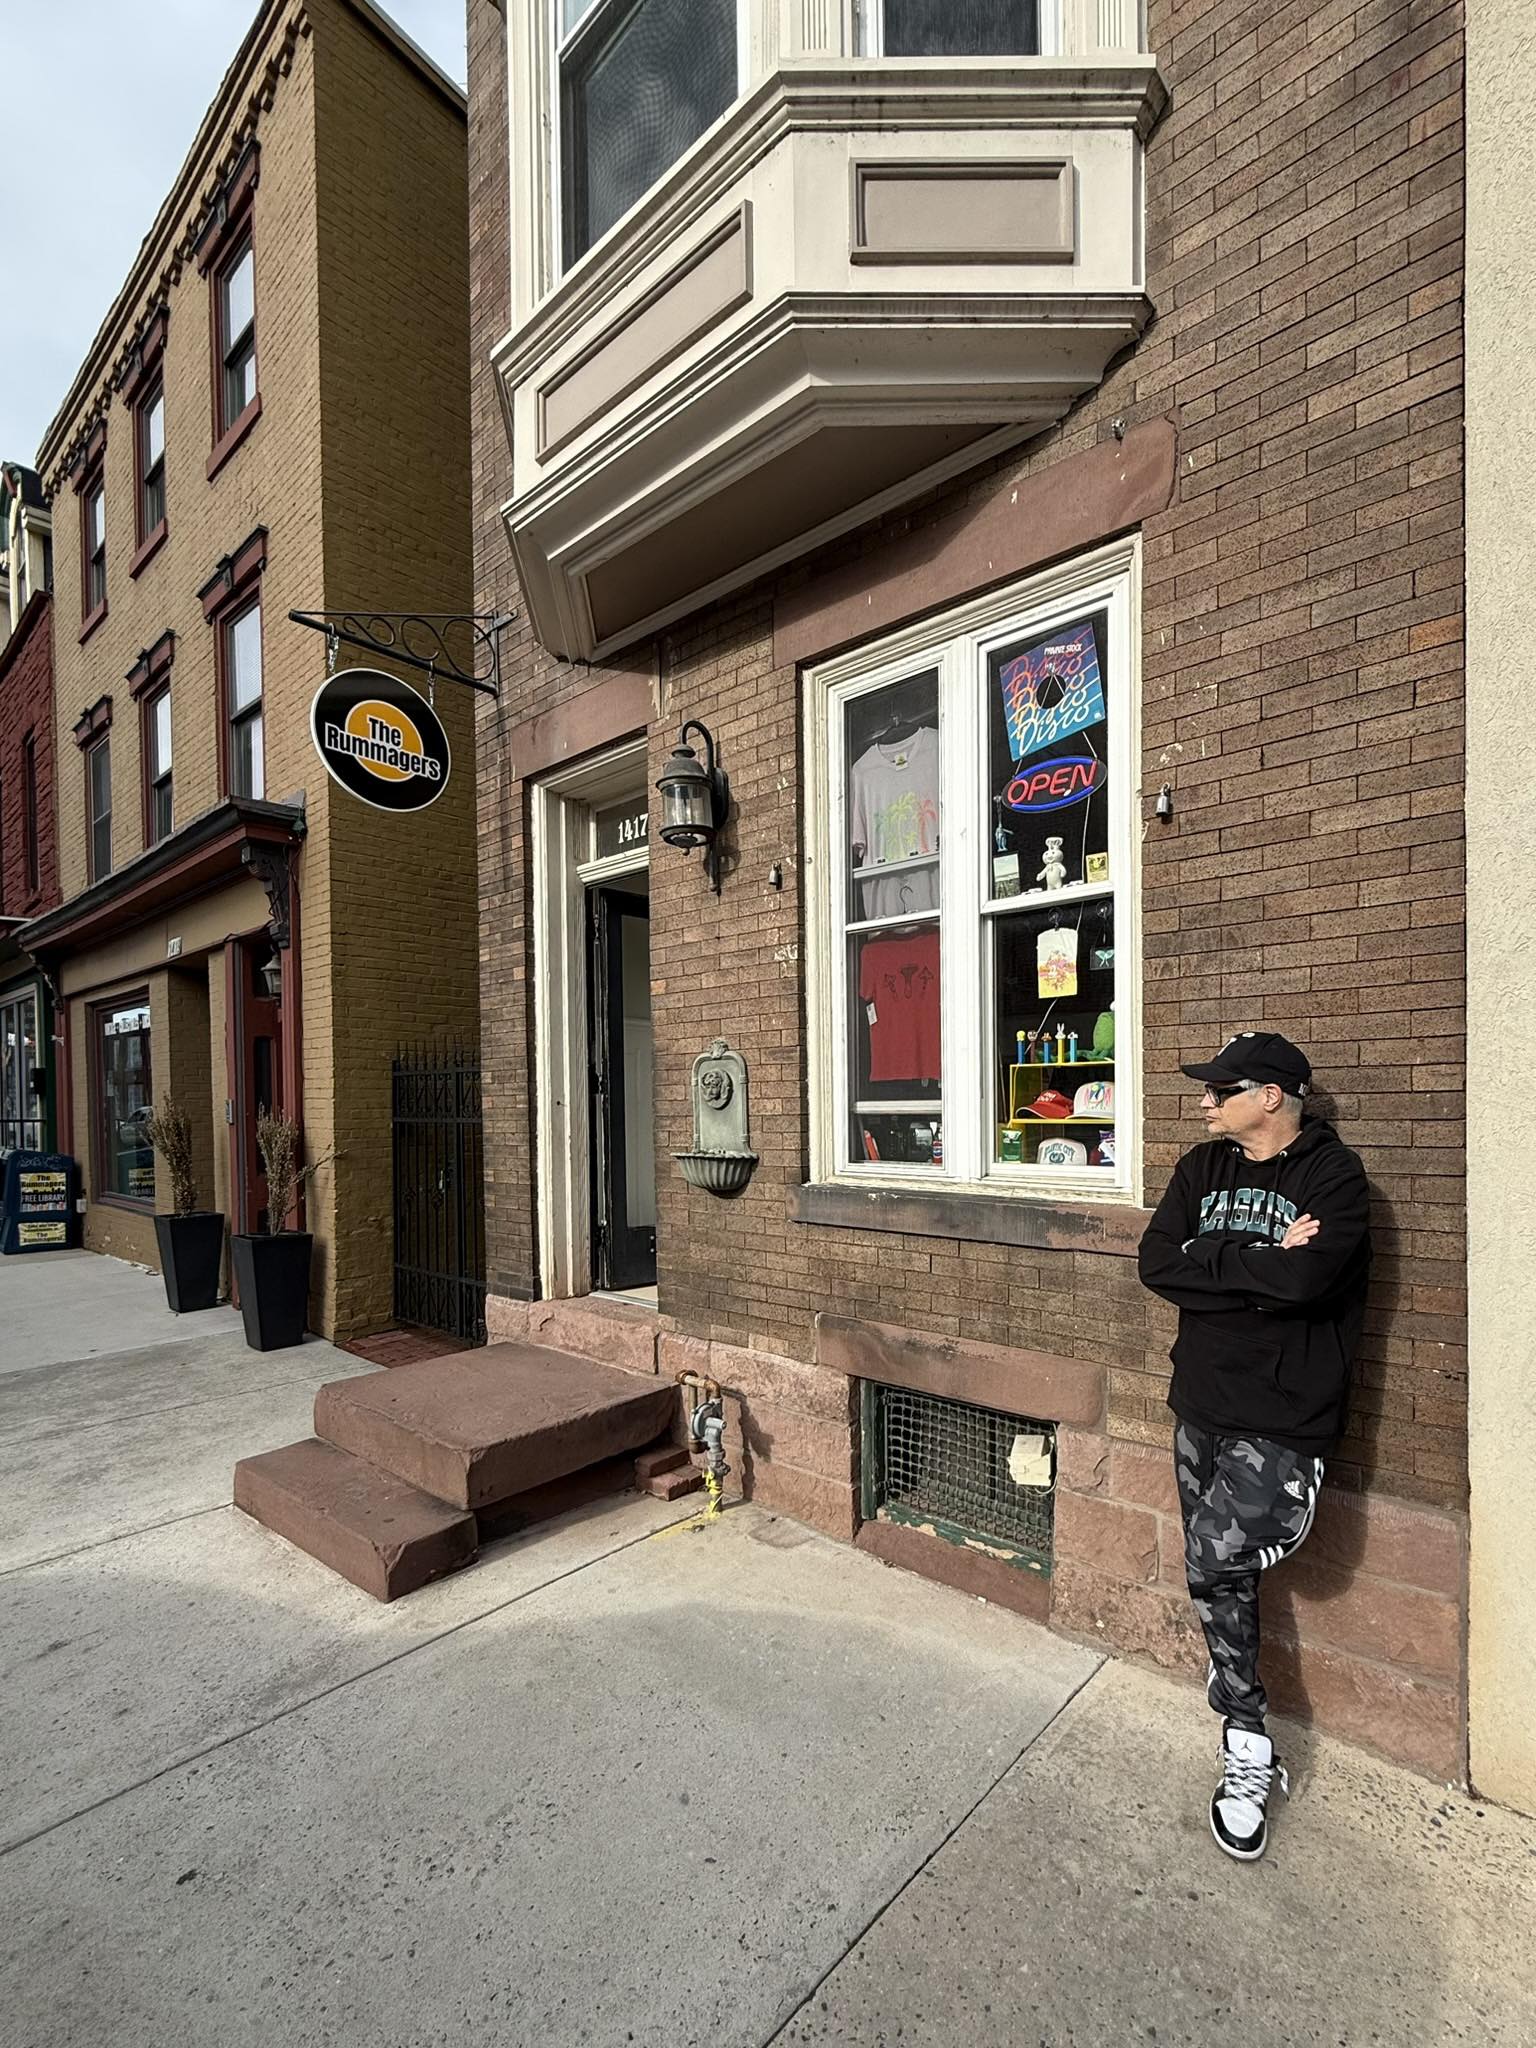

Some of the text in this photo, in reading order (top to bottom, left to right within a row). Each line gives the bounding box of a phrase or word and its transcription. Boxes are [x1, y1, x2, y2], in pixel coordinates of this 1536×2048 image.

[1044, 643, 1082, 655] PRIVATE STOCK
[368, 715, 402, 747] The
[1011, 695, 1099, 755] Disco
[326, 723, 440, 780] Rummagers
[1007, 761, 1097, 804] OPEN
[618, 813, 648, 843] 1417
[21, 1193, 65, 1203] FREE LIBRARY
